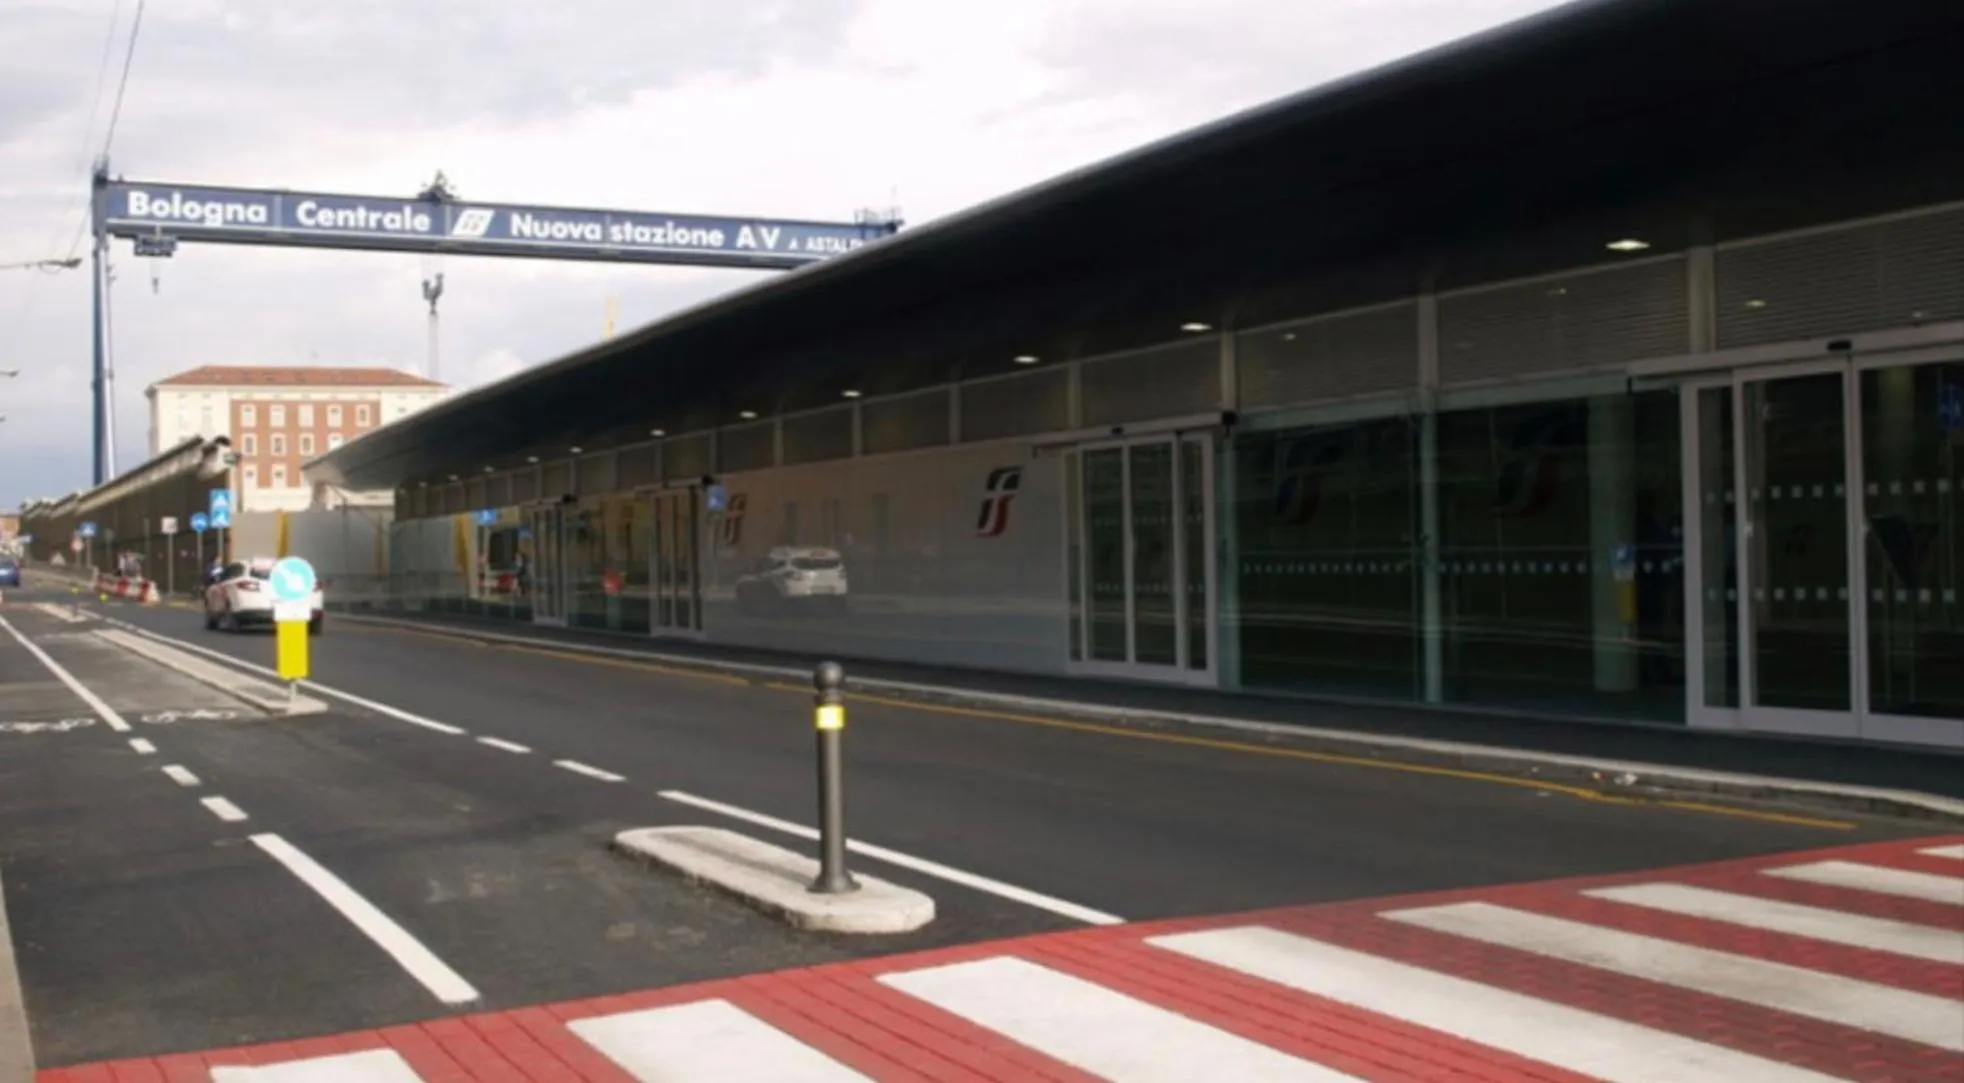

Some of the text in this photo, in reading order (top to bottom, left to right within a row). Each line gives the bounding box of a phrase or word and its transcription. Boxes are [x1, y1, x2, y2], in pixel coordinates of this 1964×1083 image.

[127, 190, 267, 227] Bologna
[296, 202, 431, 232] Centrale
[510, 212, 602, 240] Nuova
[609, 217, 725, 248] stazione
